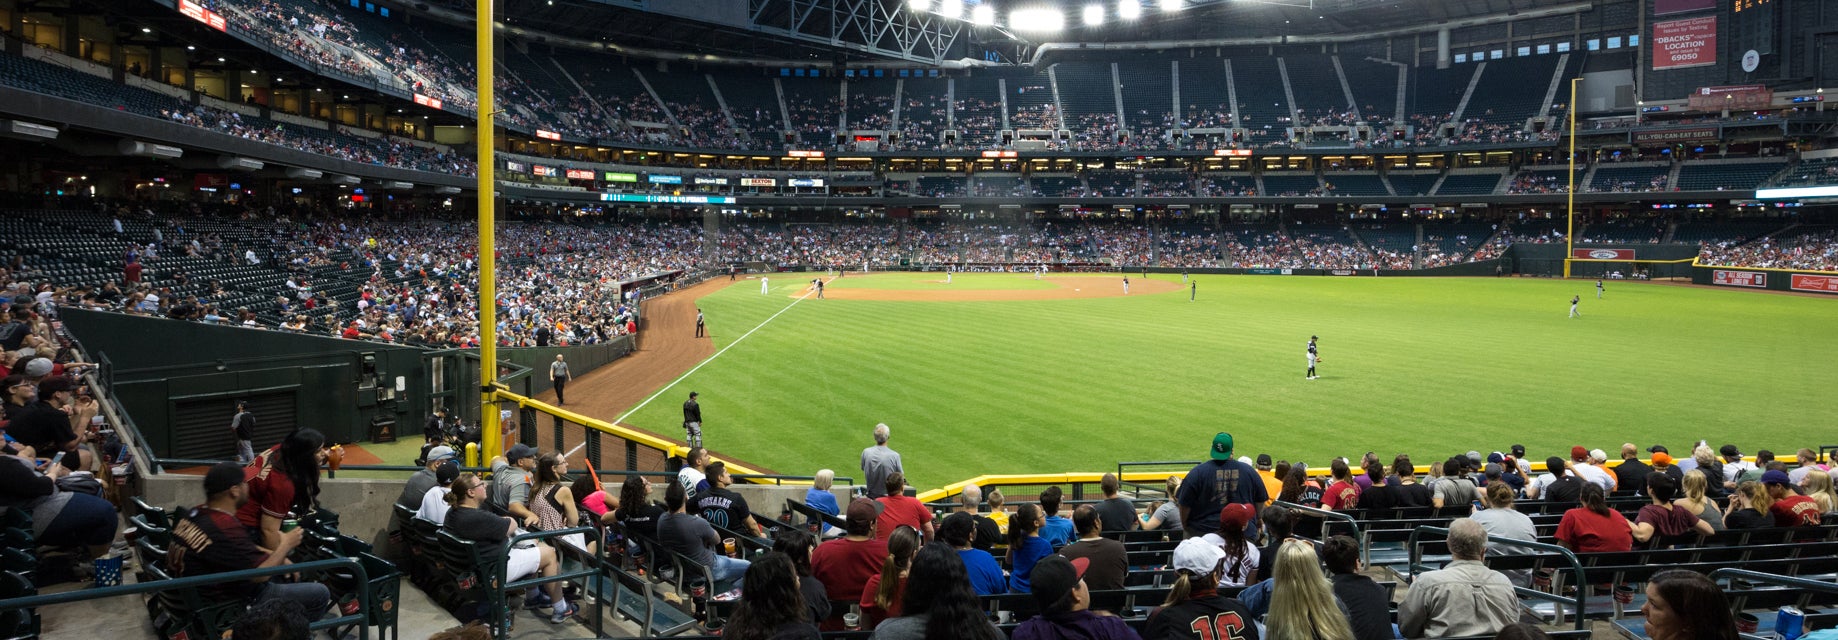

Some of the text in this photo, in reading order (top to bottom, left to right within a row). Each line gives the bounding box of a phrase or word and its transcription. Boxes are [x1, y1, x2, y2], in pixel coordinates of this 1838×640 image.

[1664, 40, 1705, 50] LOCATION
[1671, 53, 1698, 61] 69050
[1637, 132, 1691, 140] ALL-YOU-CAN-EAT
[703, 508, 729, 529] 20
[1190, 610, 1246, 640] 16
